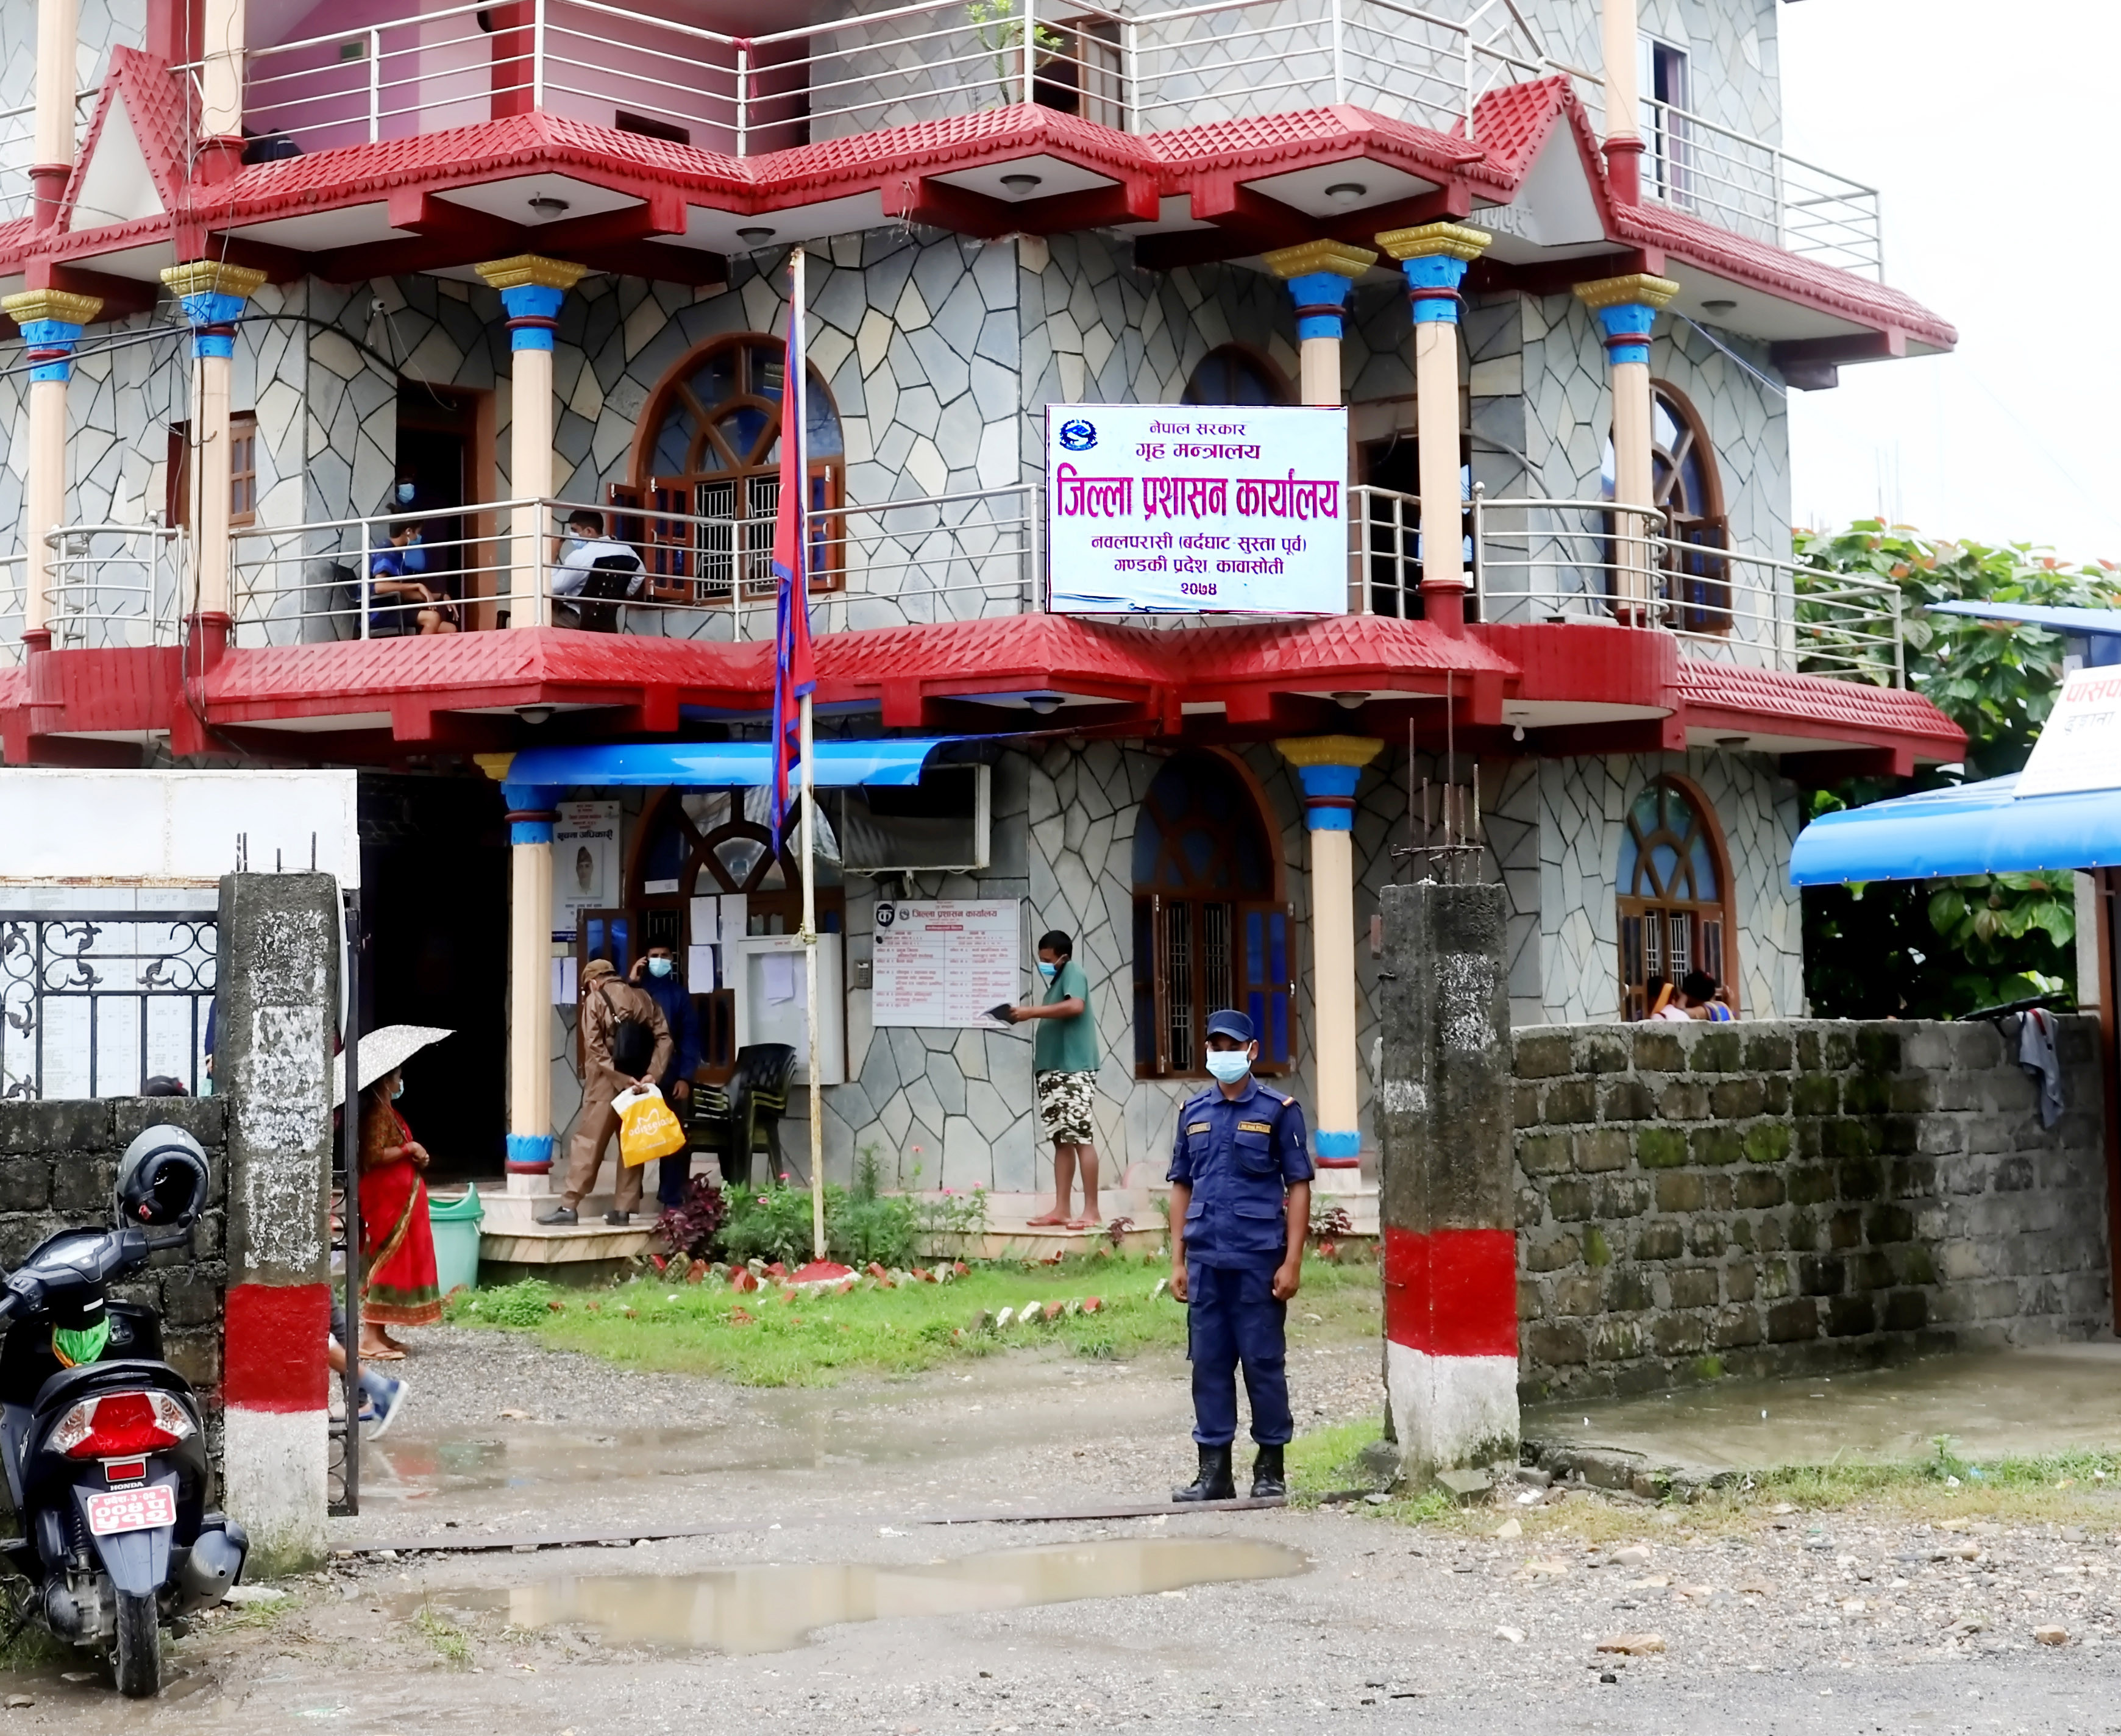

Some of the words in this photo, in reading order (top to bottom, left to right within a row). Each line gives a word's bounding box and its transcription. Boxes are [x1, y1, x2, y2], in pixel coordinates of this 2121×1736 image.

[1149, 420, 1190, 435] नेपाल
[1196, 423, 1246, 436] सरकार
[1135, 443, 1165, 462] गृह
[1173, 443, 1261, 460] मन्त्रालय
[1056, 462, 1134, 518] जिल्ला
[1142, 476, 1229, 521] प्रशासन
[1236, 468, 1340, 521] कार्यालय
[1092, 532, 1173, 550] नवलपरासी
[1281, 535, 1307, 556] पूर्व)
[1114, 555, 1168, 572] गण्डकी
[1216, 557, 1284, 575] कावासोती
[1181, 582, 1217, 596] २०७४
[912, 908, 936, 918] जिल्ला
[937, 911, 964, 919] प्रशासन
[965, 908, 998, 918] कार्यालय
[110, 1481, 144, 1491] HONDA
